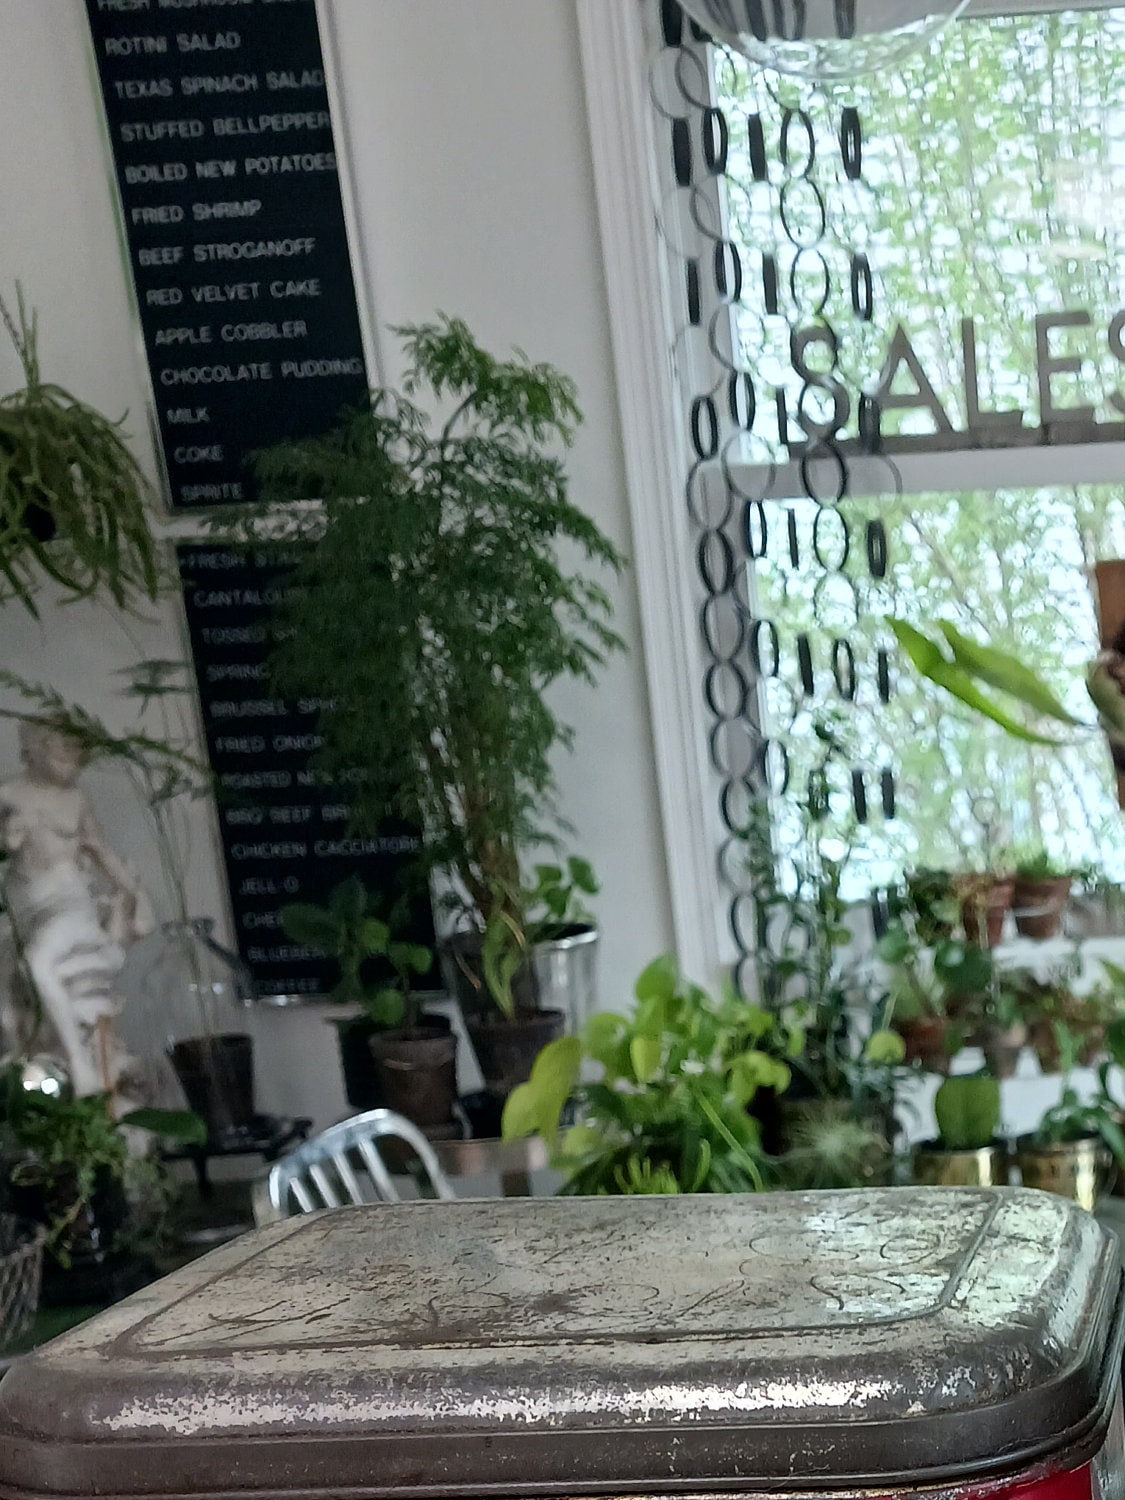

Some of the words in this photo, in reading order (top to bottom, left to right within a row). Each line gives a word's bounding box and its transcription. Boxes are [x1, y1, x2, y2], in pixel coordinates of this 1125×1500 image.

[105, 36, 167, 56] ROTINI
[176, 31, 241, 52] SALAD
[114, 78, 174, 100] TEXAS
[180, 73, 258, 95] SPINACH
[120, 120, 205, 142] STUFFED
[124, 162, 188, 184] BOILED
[195, 159, 238, 179] NEW
[244, 152, 337, 175] POTATOES
[131, 205, 185, 225] FRIED
[191, 199, 262, 221] SHRIMP
[138, 245, 184, 266] BEEF
[192, 237, 317, 262] STROGANOFF
[146, 287, 183, 306] RED
[190, 282, 261, 304] VELVET
[269, 278, 322, 299] CAKE
[154, 325, 212, 346] APPLE
[220, 320, 309, 342] COBBLER
[160, 362, 272, 386] CHOCOLATE
[280, 357, 364, 379] PUDDING
[167, 407, 210, 424] MILK
[174, 445, 224, 464] COKE
[231, 841, 307, 860] CHICKEN
